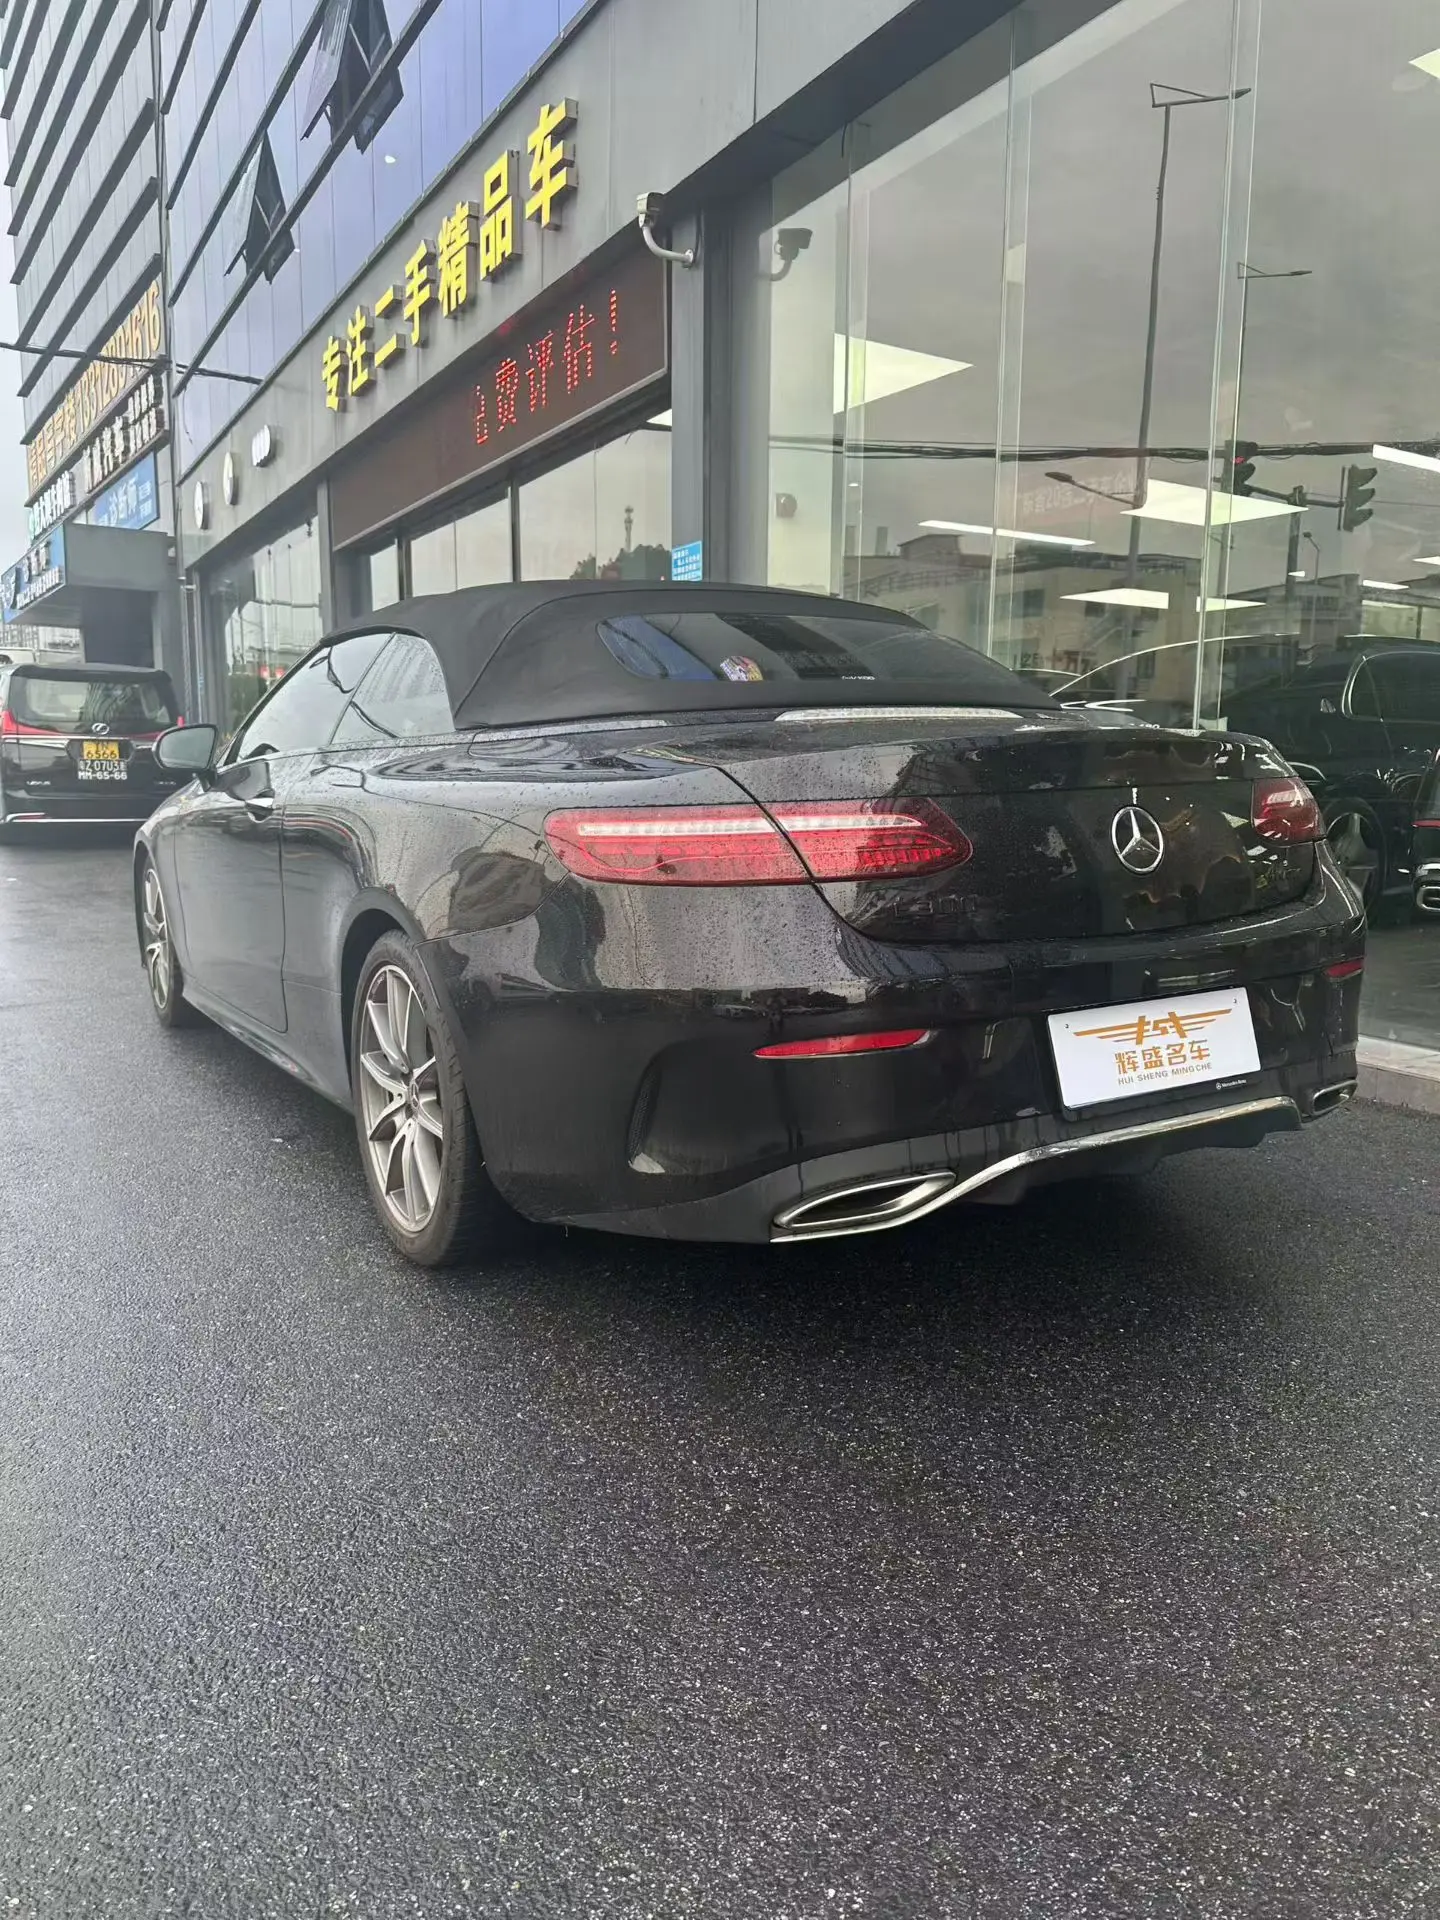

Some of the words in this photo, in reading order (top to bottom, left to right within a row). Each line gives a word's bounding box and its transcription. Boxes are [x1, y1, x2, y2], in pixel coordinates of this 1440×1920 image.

[322, 98, 574, 412] 专注二手精品车
[86, 750, 117, 759] 6566
[78, 771, 127, 780] MM-65-66
[1114, 1039, 1211, 1075] 辉盛名车
[1117, 1076, 1134, 1085] HUI
[1137, 1070, 1168, 1082] SHENG
